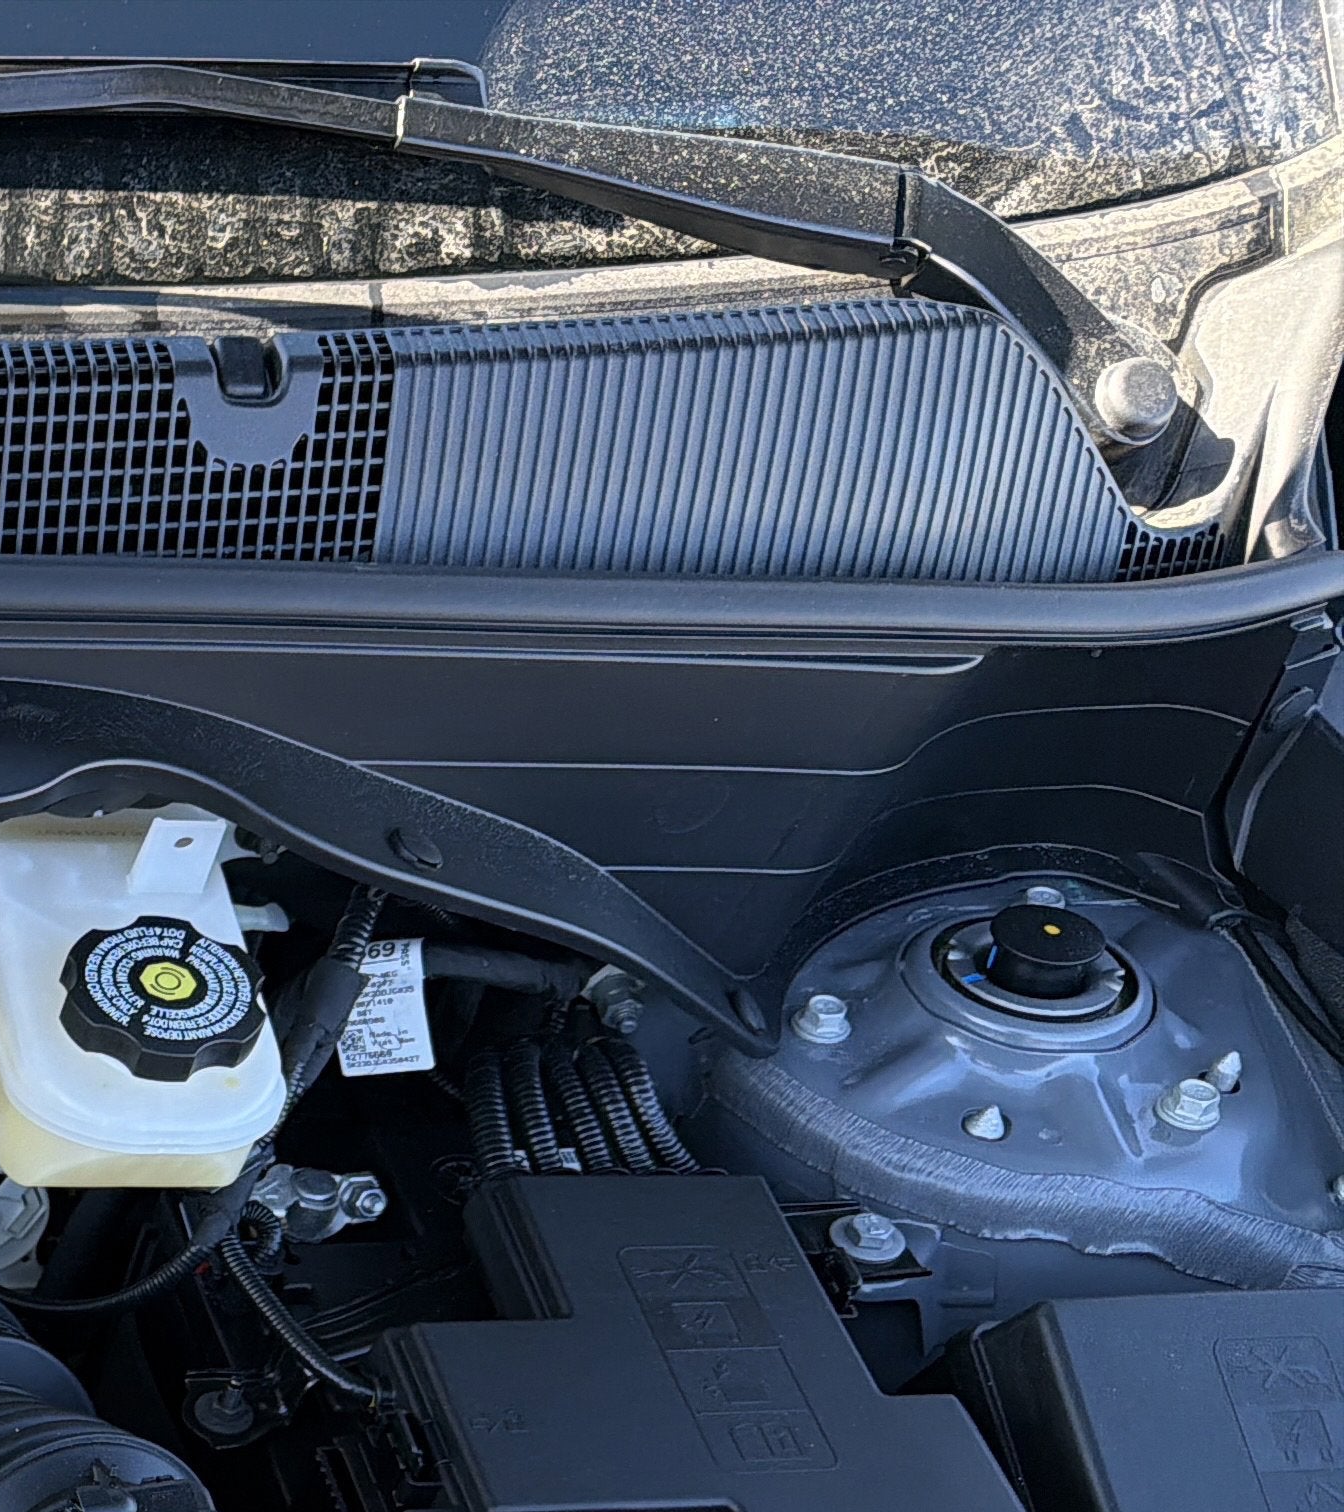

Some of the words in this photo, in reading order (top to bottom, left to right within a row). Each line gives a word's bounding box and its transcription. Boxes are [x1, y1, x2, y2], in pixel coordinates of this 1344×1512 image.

[121, 926, 154, 939] FLUID
[162, 927, 186, 939] DOT
[159, 936, 184, 948] CAP
[115, 983, 144, 1009] FILLER
[108, 996, 138, 1018] ONLY
[149, 1017, 167, 1029] DOT
